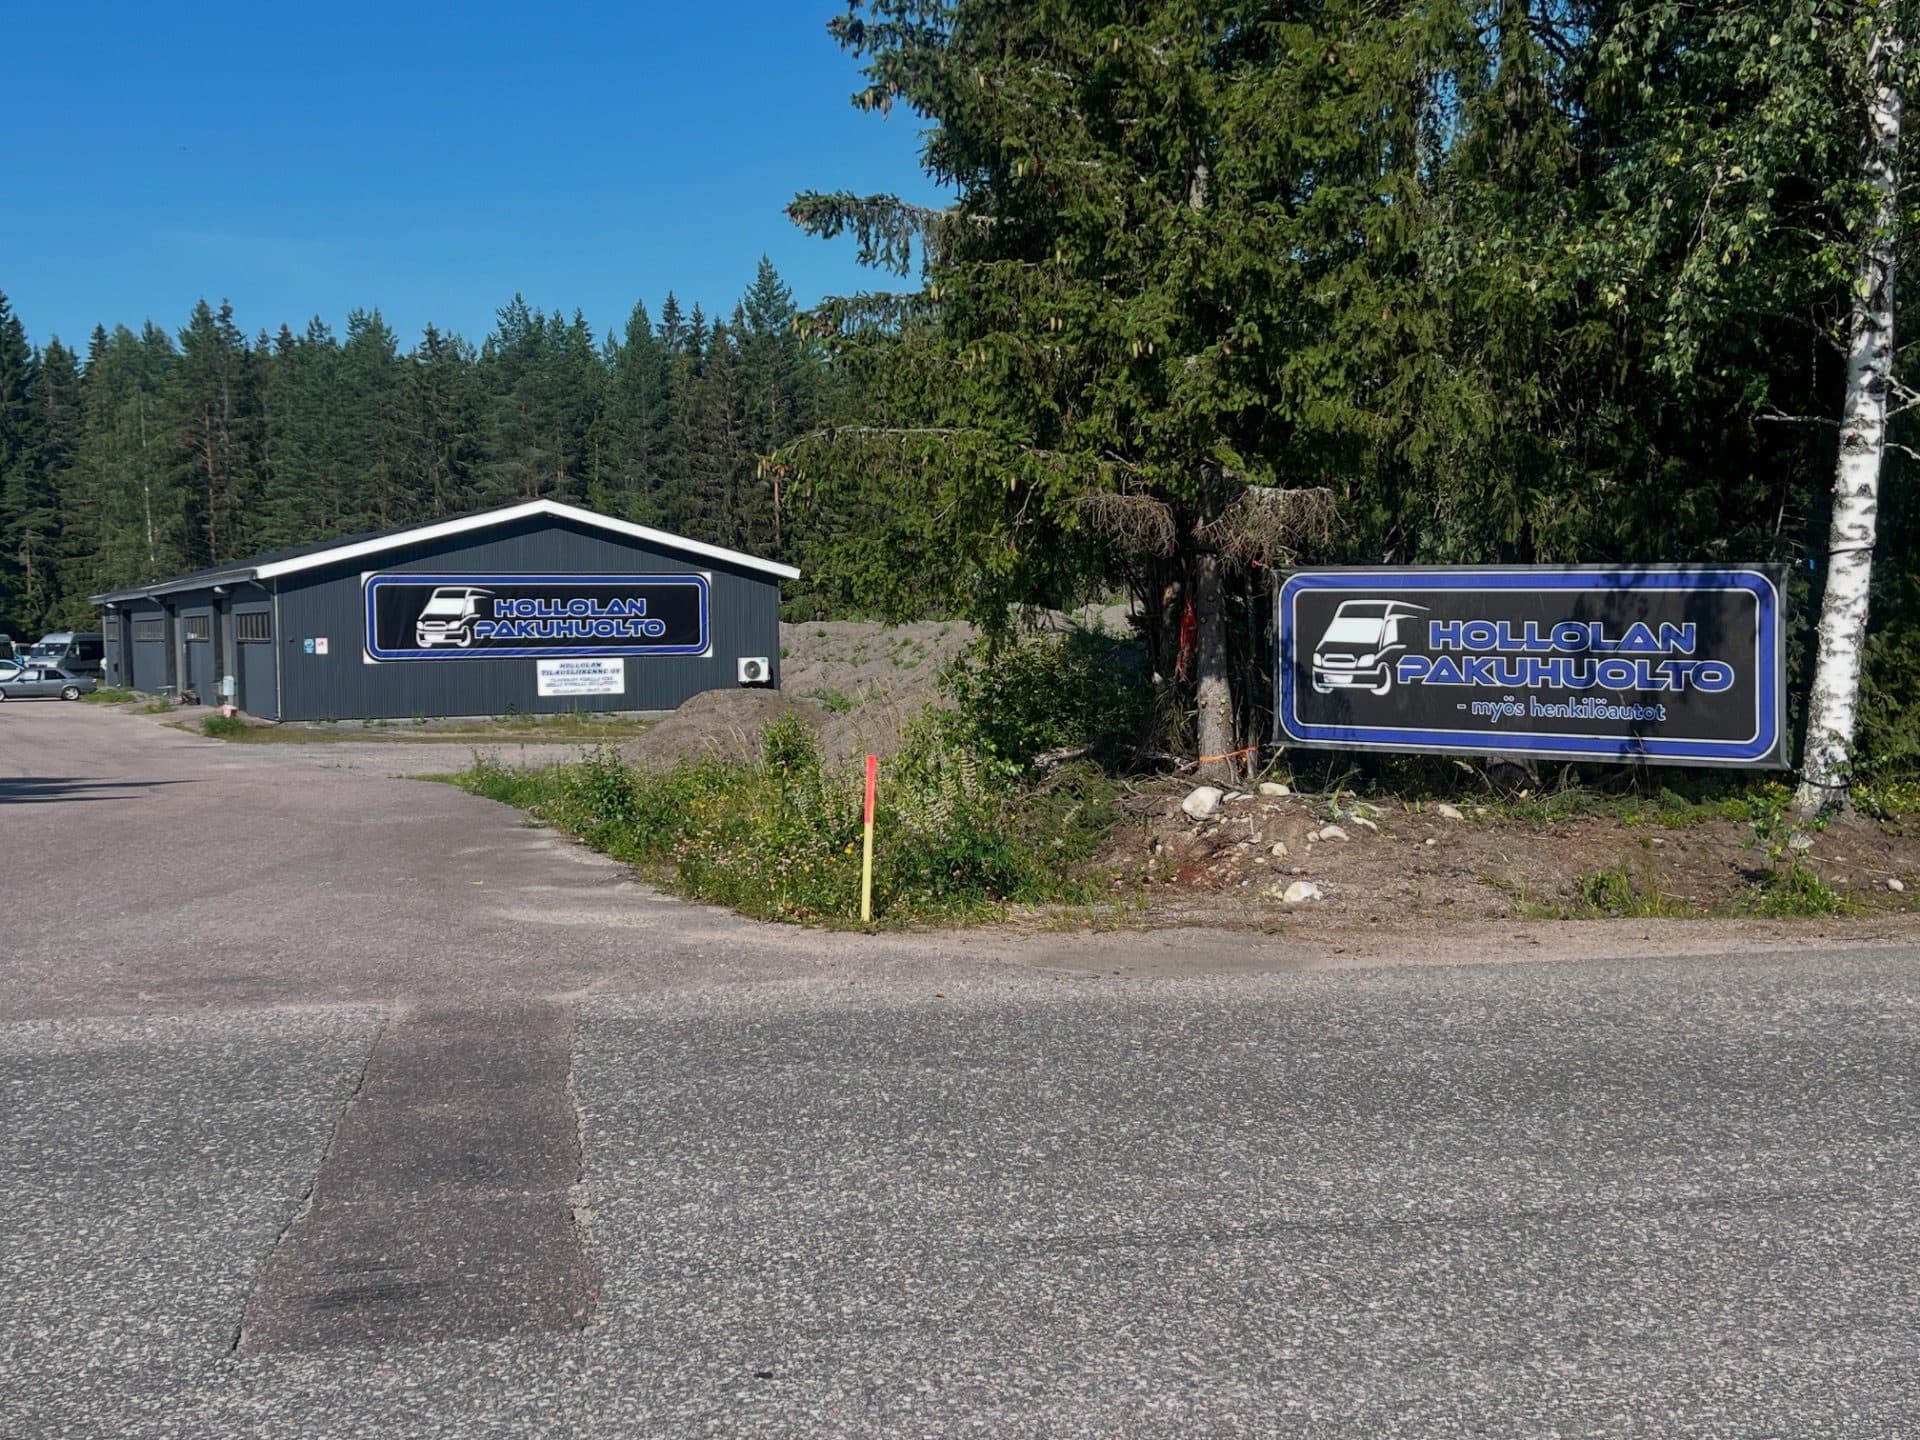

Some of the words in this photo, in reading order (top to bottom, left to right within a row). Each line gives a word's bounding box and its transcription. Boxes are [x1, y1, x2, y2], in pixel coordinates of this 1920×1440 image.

[494, 598, 647, 617] HOLLOLAN
[474, 619, 666, 639] PAKUHUOLTO
[1429, 620, 1696, 655] HOLLOLAN
[1396, 655, 1735, 692] PAKUHUOLTO
[1472, 696, 1525, 723] myös
[1530, 696, 1666, 722] henkilöautot
